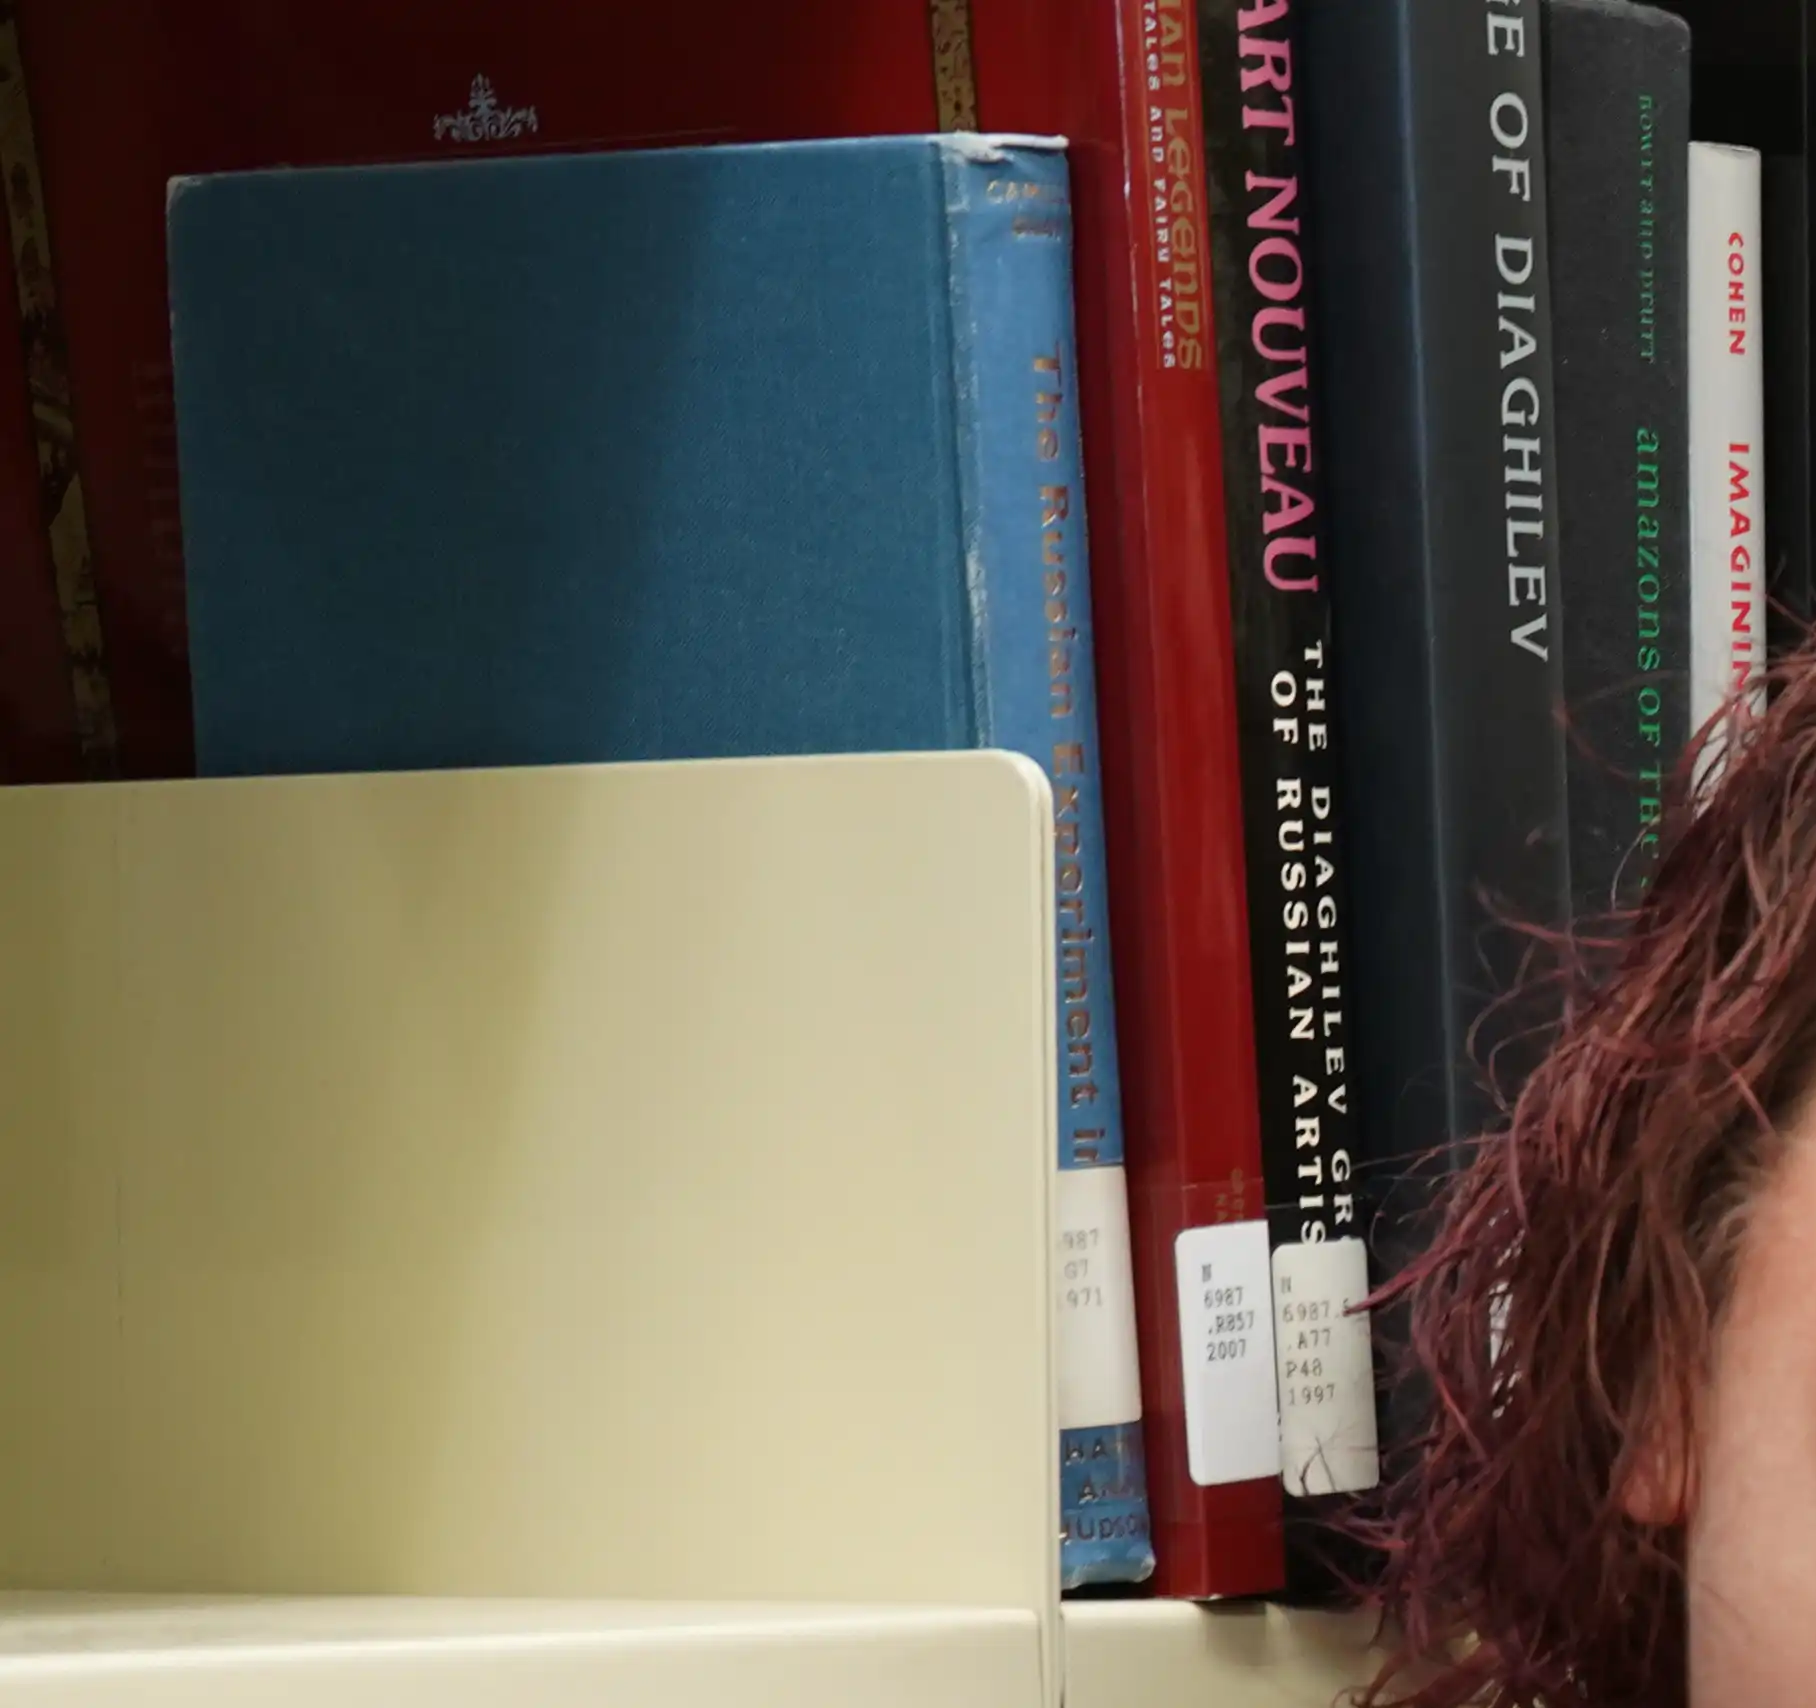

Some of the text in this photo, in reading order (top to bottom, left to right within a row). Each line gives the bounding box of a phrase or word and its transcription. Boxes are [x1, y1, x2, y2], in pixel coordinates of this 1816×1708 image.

[1489, 92, 1531, 202] OF
[1237, 0, 1320, 594] ART NOUVEAU
[1728, 231, 1746, 356] COHEN
[1034, 341, 1065, 462] The
[1494, 234, 1550, 663] DIAGHILEV
[1040, 484, 1079, 719] Russian
[1270, 671, 1298, 745] OF
[1054, 742, 1100, 1108] Experiment
[1277, 777, 1315, 1042] RUSSIAN
[1304, 640, 1355, 1243] THE DIAGHILEV GR
[1204, 1285, 1244, 1309] 6987
[1206, 1338, 1247, 1362] 2007
[1288, 1383, 1336, 1407] 1997
